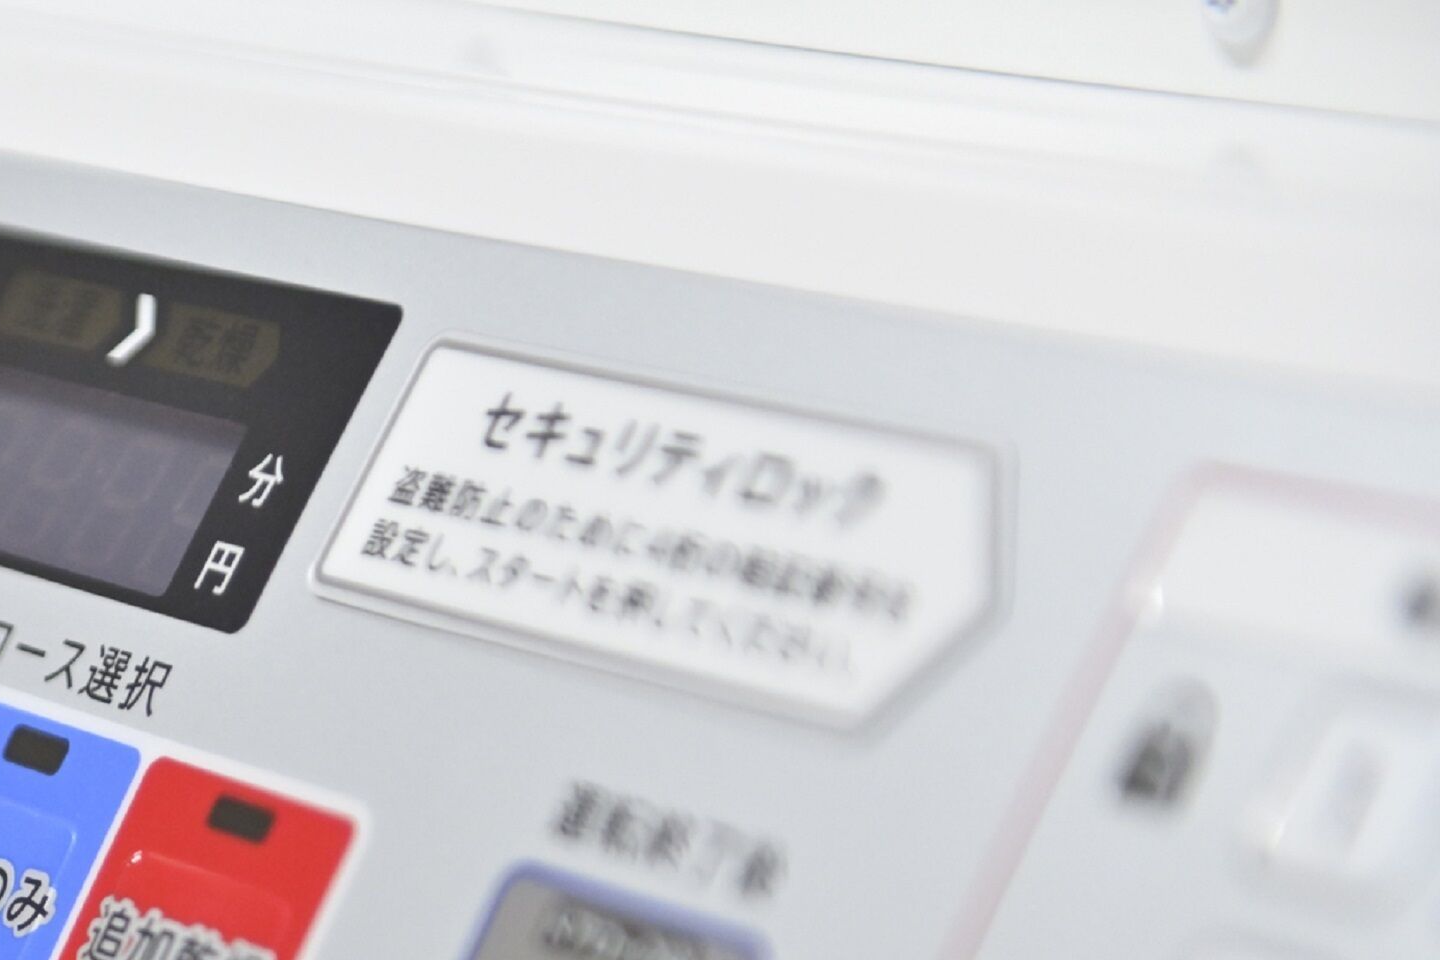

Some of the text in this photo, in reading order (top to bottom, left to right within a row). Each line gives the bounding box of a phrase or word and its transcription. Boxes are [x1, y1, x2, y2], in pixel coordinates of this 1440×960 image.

[238, 453, 284, 509] 分
[483, 392, 885, 526] セキュリティロック
[194, 540, 246, 596] 円
